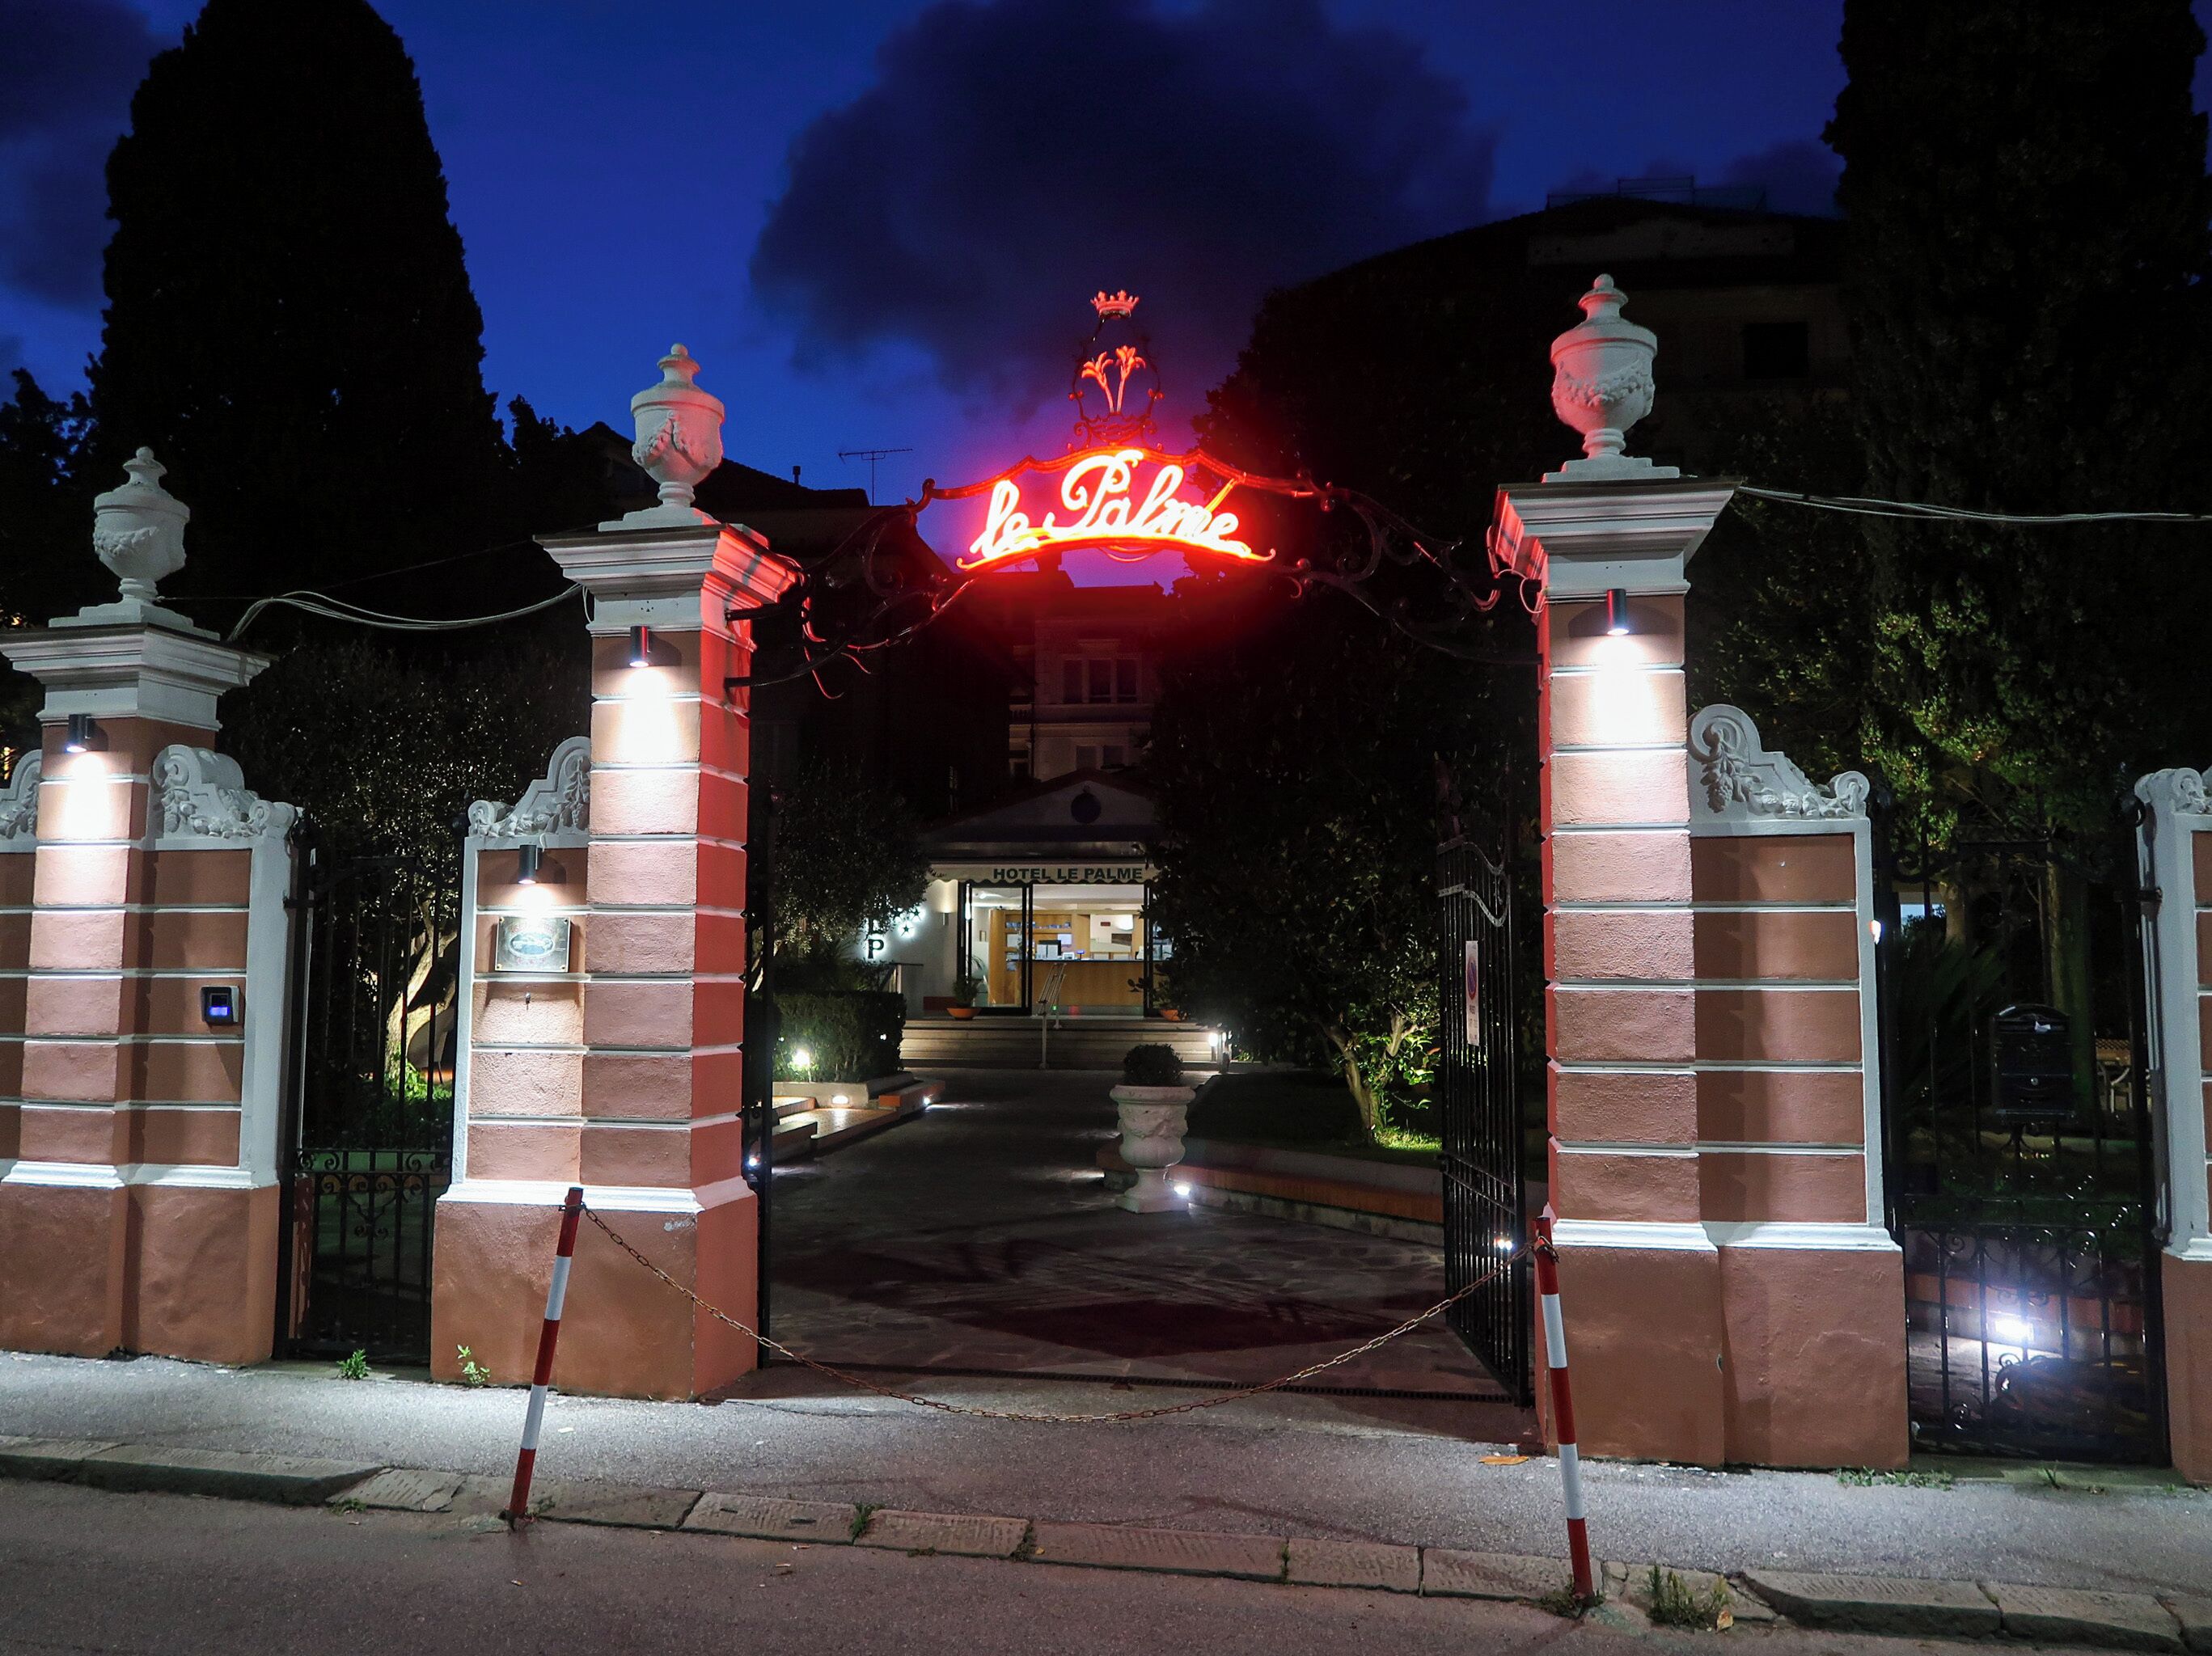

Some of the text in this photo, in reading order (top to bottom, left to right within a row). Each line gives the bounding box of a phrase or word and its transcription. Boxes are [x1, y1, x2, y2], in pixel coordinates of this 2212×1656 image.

[1043, 449, 1253, 557] Palme
[993, 868, 1143, 880] HOTEL LE PALME
